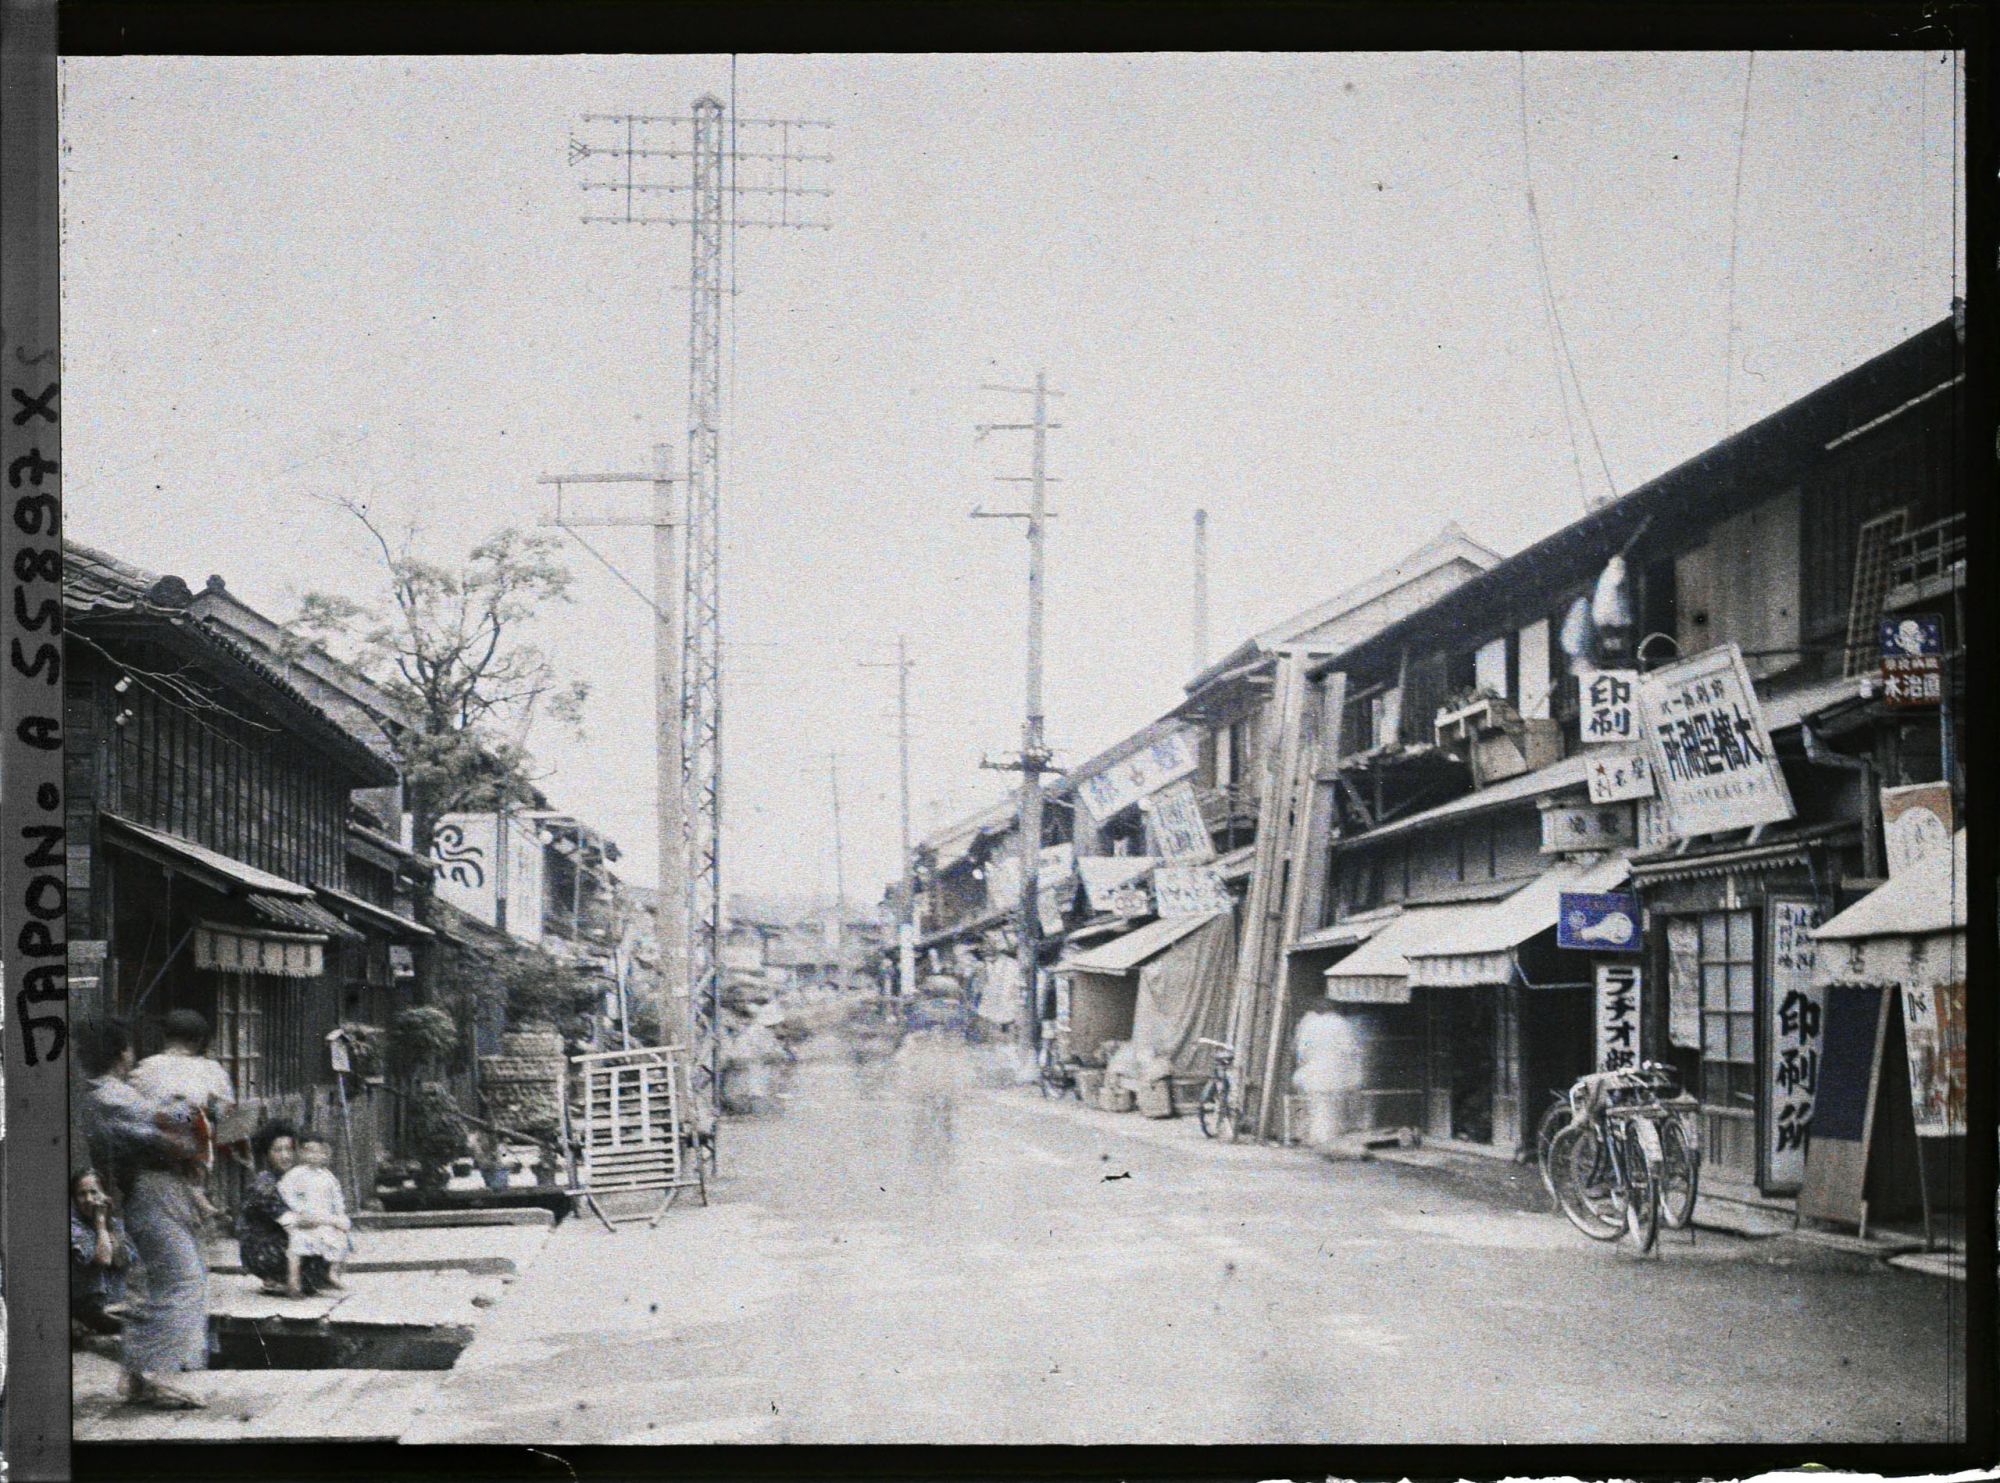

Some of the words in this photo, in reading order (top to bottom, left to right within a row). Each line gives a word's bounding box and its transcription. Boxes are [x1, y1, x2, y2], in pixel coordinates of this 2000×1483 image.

[9, 447, 62, 686] 55897
[16, 715, 63, 751] A
[1589, 675, 1632, 736] 印刷
[1777, 989, 1822, 1164] 印刷所
